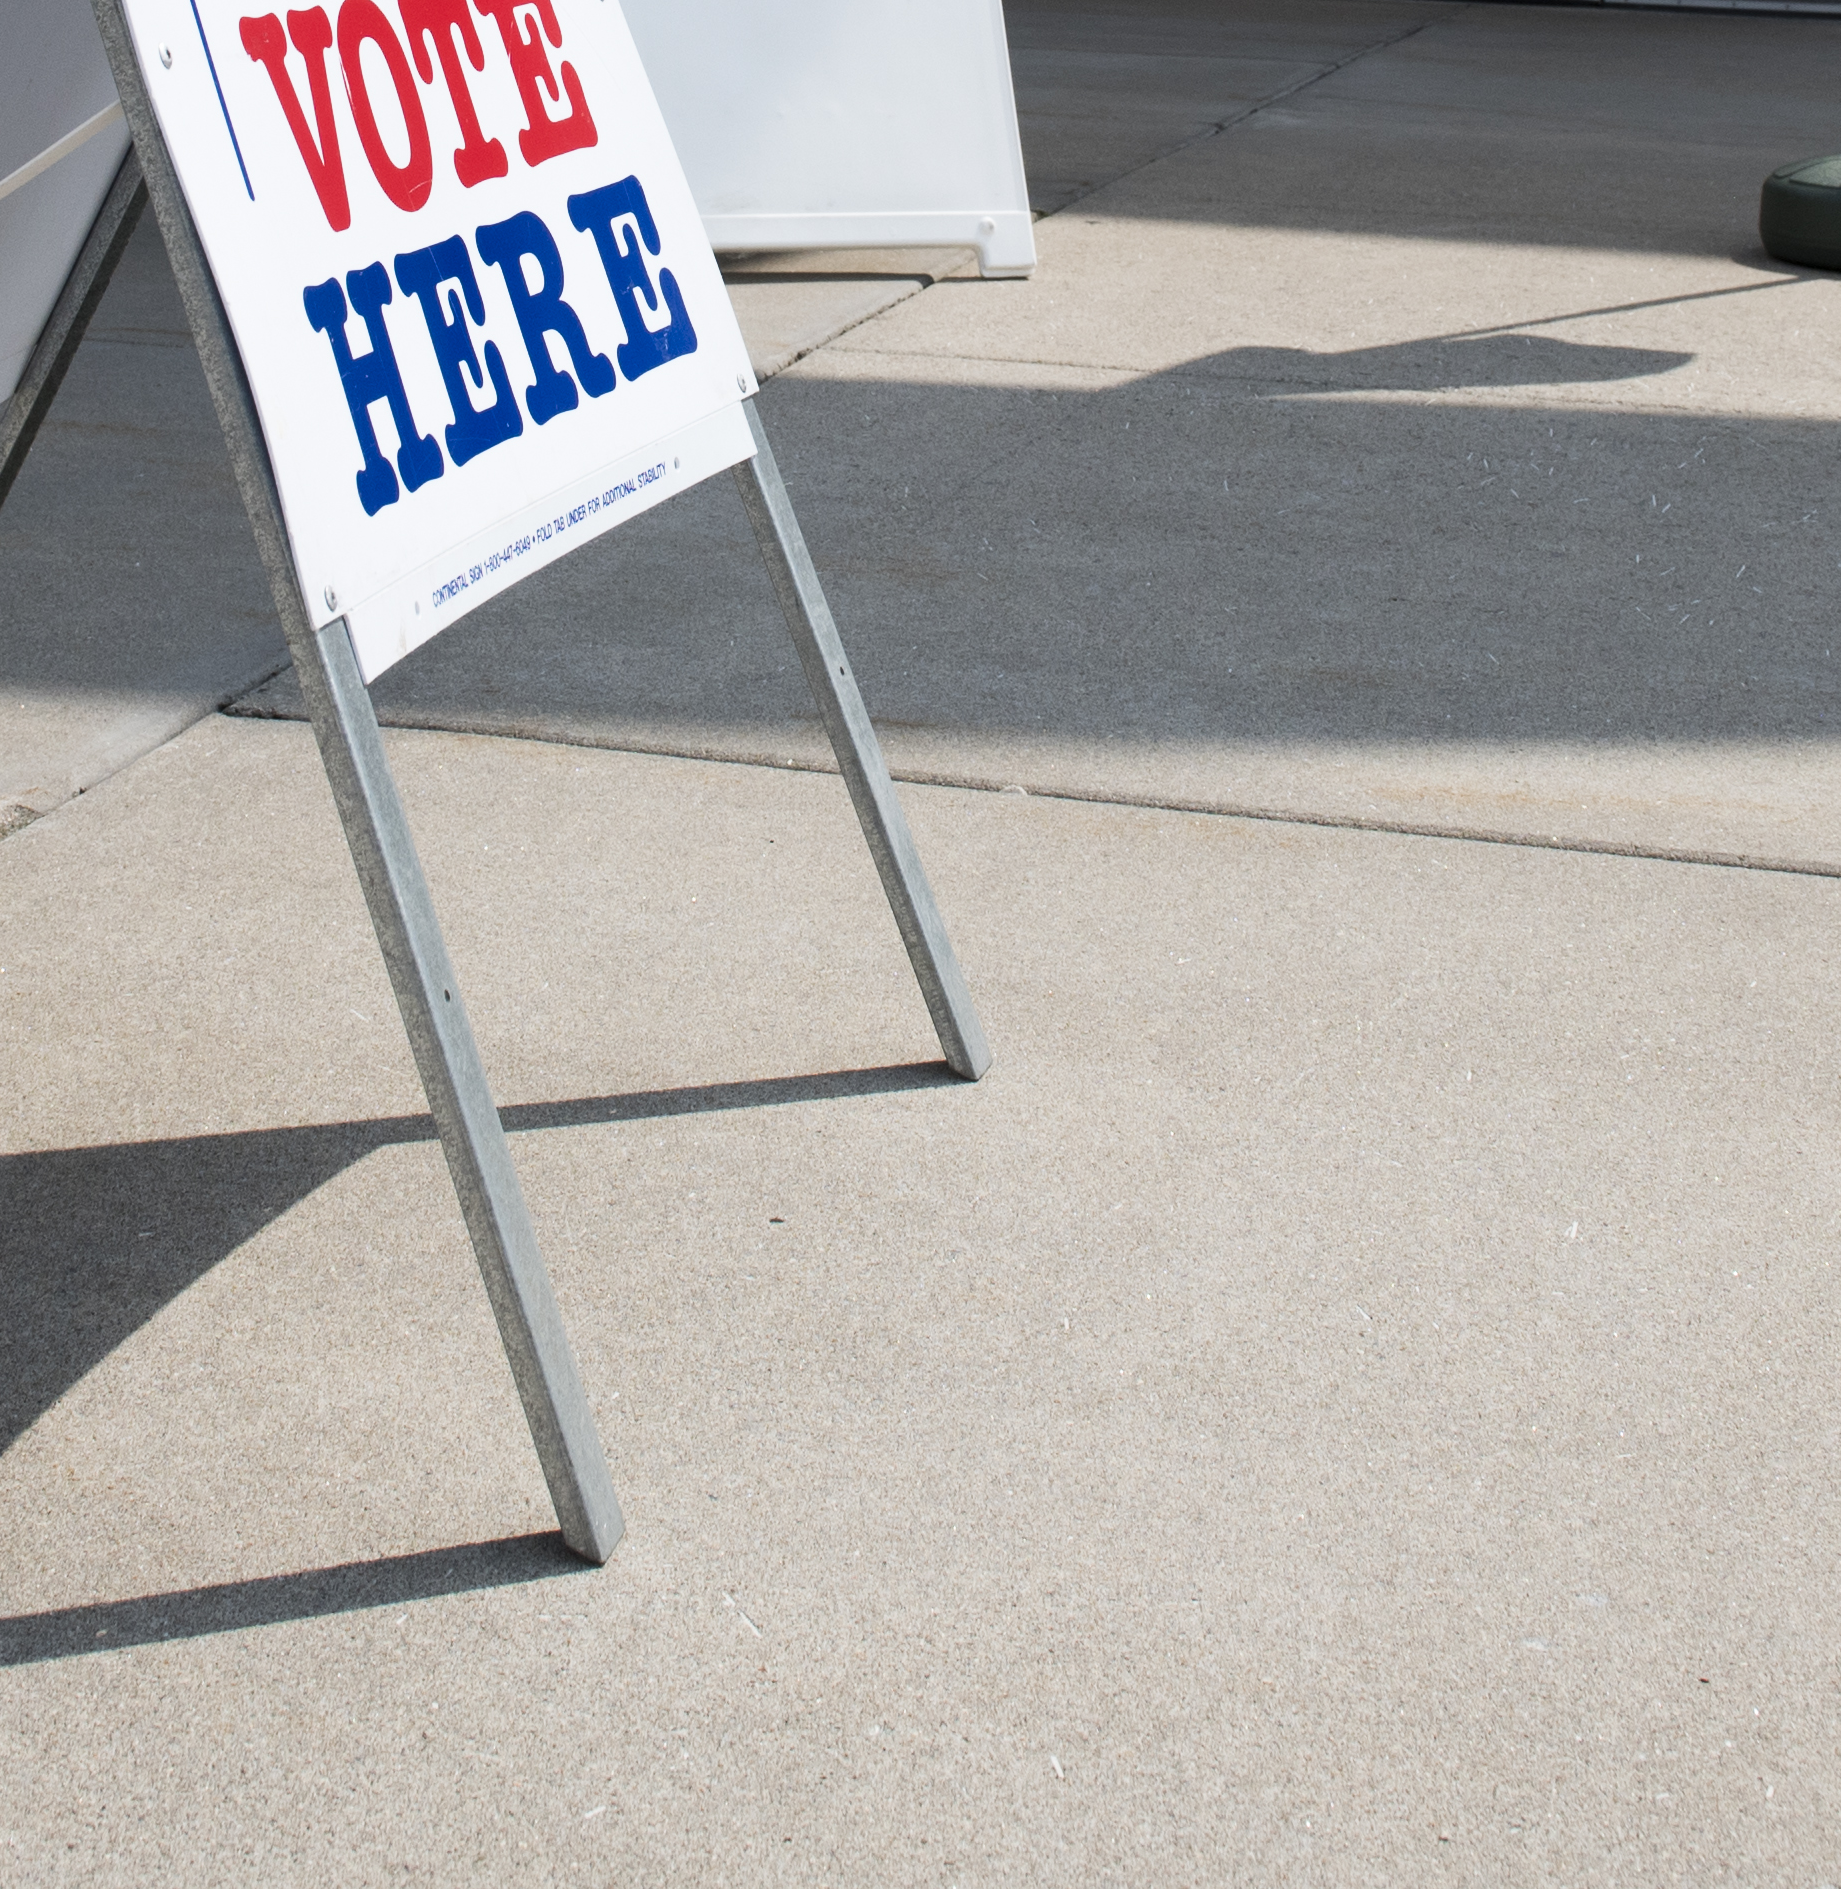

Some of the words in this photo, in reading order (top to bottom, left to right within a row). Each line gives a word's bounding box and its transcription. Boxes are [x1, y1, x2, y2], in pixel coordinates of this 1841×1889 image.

[303, 175, 698, 516] HERE
[432, 573, 469, 608] CONTINENTAL
[468, 562, 483, 584] SIGN
[483, 535, 531, 575] 1-800-447-6049
[536, 523, 553, 544] FOLD
[553, 516, 565, 534] TAB
[566, 504, 587, 527] UNDER
[587, 497, 601, 515] FOR
[602, 478, 637, 508] ADDITIONAL
[637, 461, 666, 488] STABILITY
